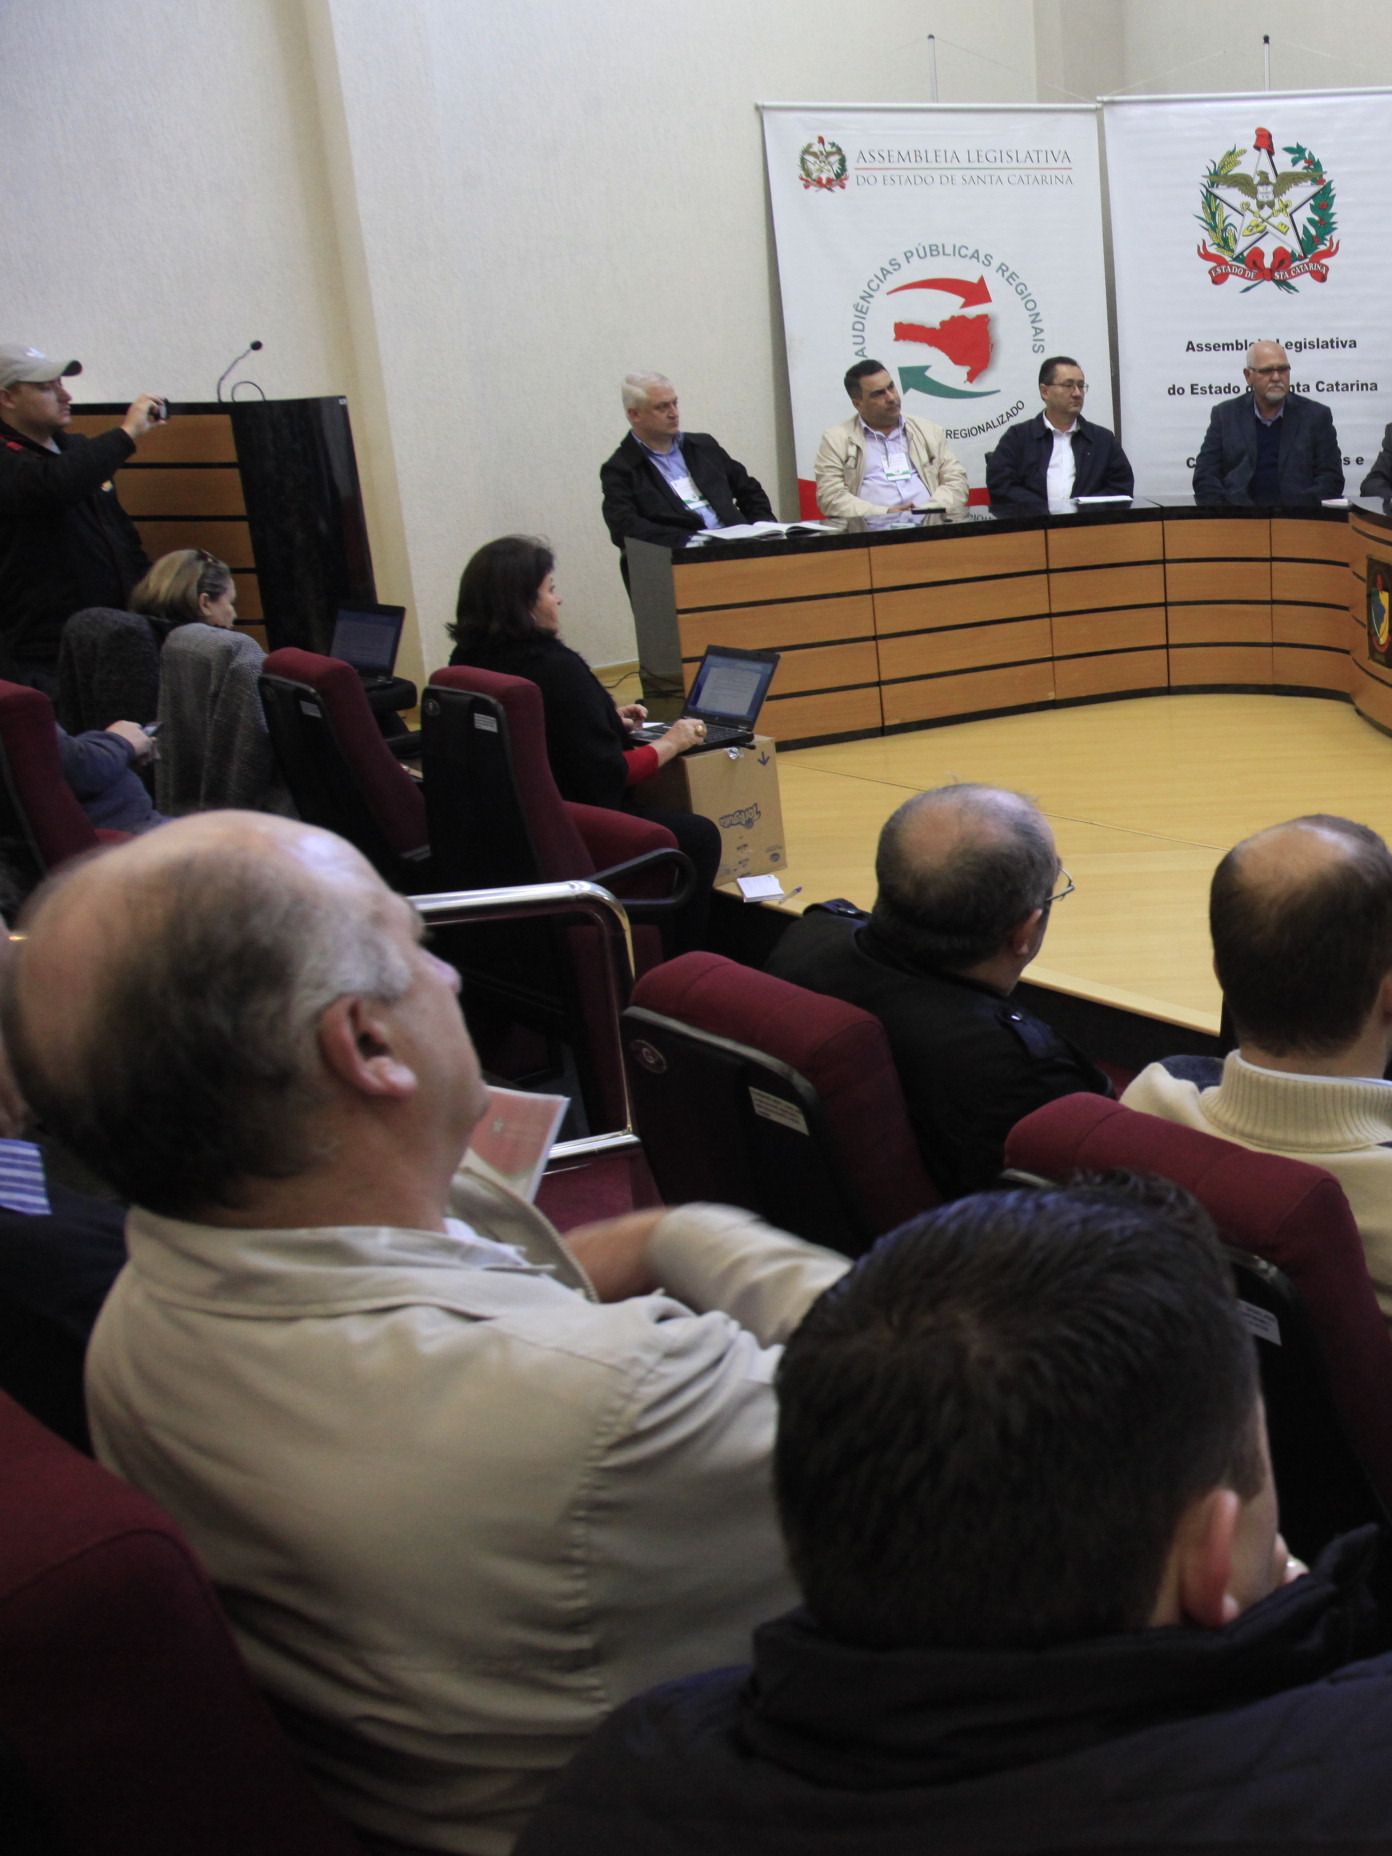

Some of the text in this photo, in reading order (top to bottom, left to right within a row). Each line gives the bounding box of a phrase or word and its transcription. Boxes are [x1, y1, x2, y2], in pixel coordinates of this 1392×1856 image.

[856, 149, 1073, 164] ASSEMBLEIA LEGISLATIVA
[856, 172, 1074, 187] DO ESTADO DE SANTA CATARINA
[1211, 262, 1327, 280] ESTADO DE STA CATARINA
[852, 242, 1046, 359] AUDIÊNCIAS PÚBLICAS REGIONAIS
[1167, 384, 1185, 396] do
[1190, 383, 1241, 395] Estado
[1315, 379, 1378, 393] Catarina
[945, 400, 1025, 440] REGIONALIZADO
[641, 1047, 656, 1064] G
